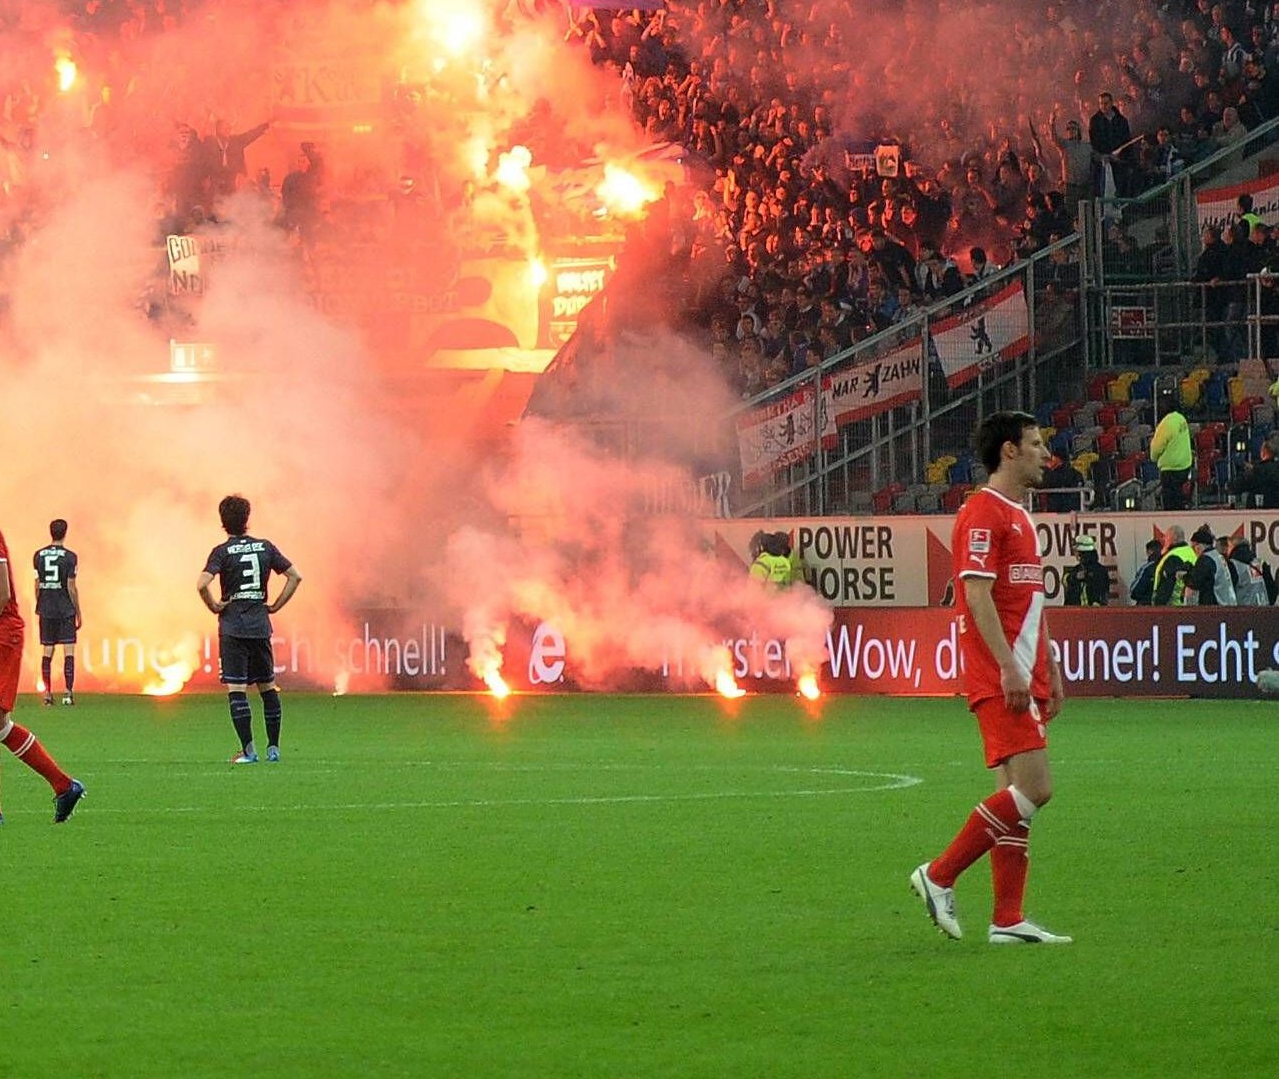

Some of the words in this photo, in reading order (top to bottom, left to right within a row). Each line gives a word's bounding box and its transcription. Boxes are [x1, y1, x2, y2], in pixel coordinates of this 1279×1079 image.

[881, 358, 921, 383] ZAHN
[799, 526, 893, 560] POWER
[44, 555, 59, 581] 5
[239, 553, 261, 591] 3
[802, 566, 895, 601] HORSE
[828, 624, 922, 688] Wow,
[1177, 622, 1260, 683] Echt
